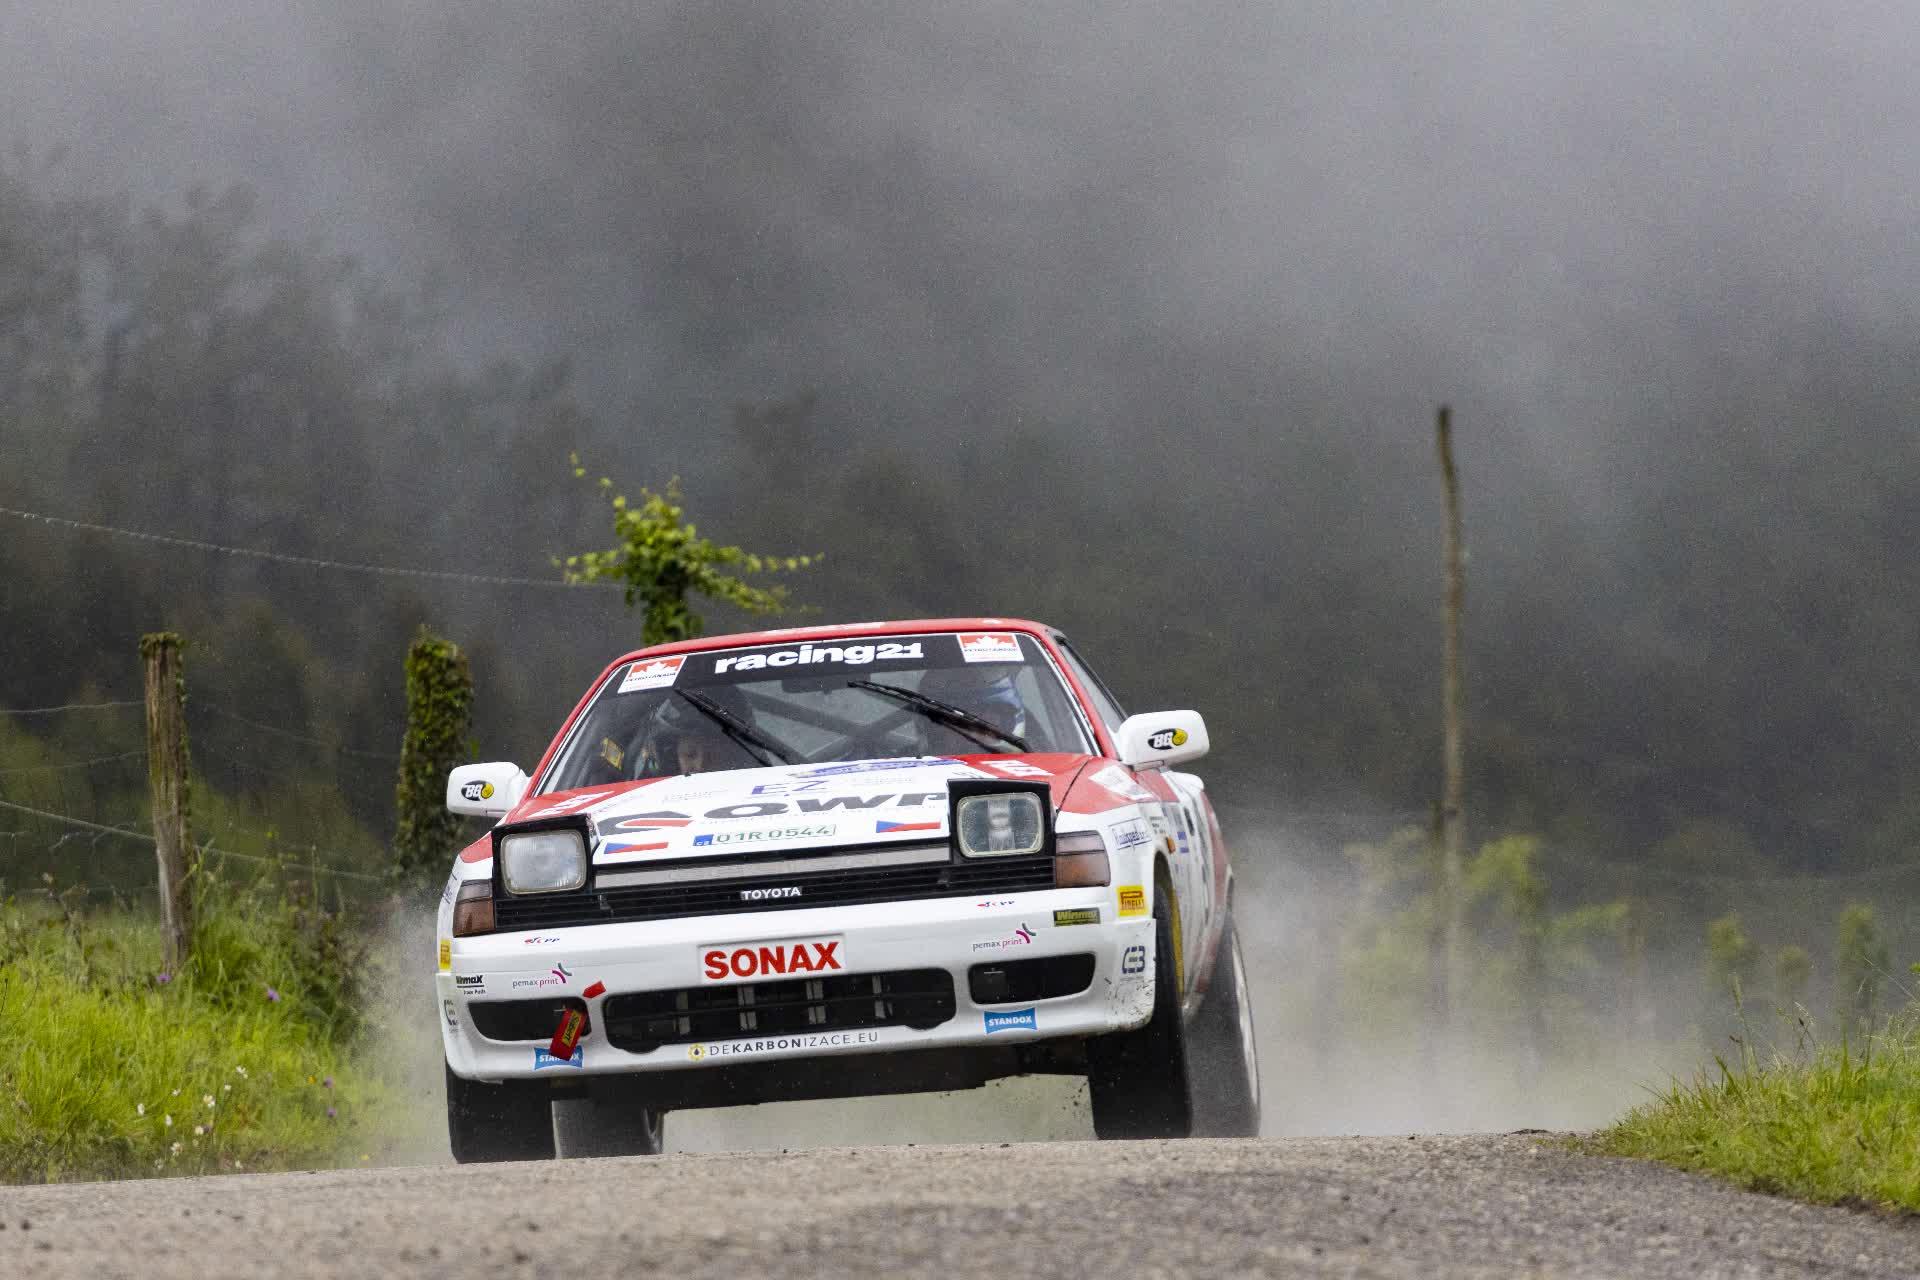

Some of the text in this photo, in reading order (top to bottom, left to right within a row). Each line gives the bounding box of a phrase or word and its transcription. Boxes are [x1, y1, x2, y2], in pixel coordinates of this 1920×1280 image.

[714, 642, 924, 674] racing21
[769, 825, 830, 838] 0544
[741, 886, 802, 900] TOYOTA
[972, 937, 1023, 952] pemax print
[704, 941, 842, 980] SONAX
[512, 978, 559, 989] pemax print
[988, 1015, 1033, 1026] STANDOX
[709, 1031, 878, 1056] DEKARBONIZACE.EU
